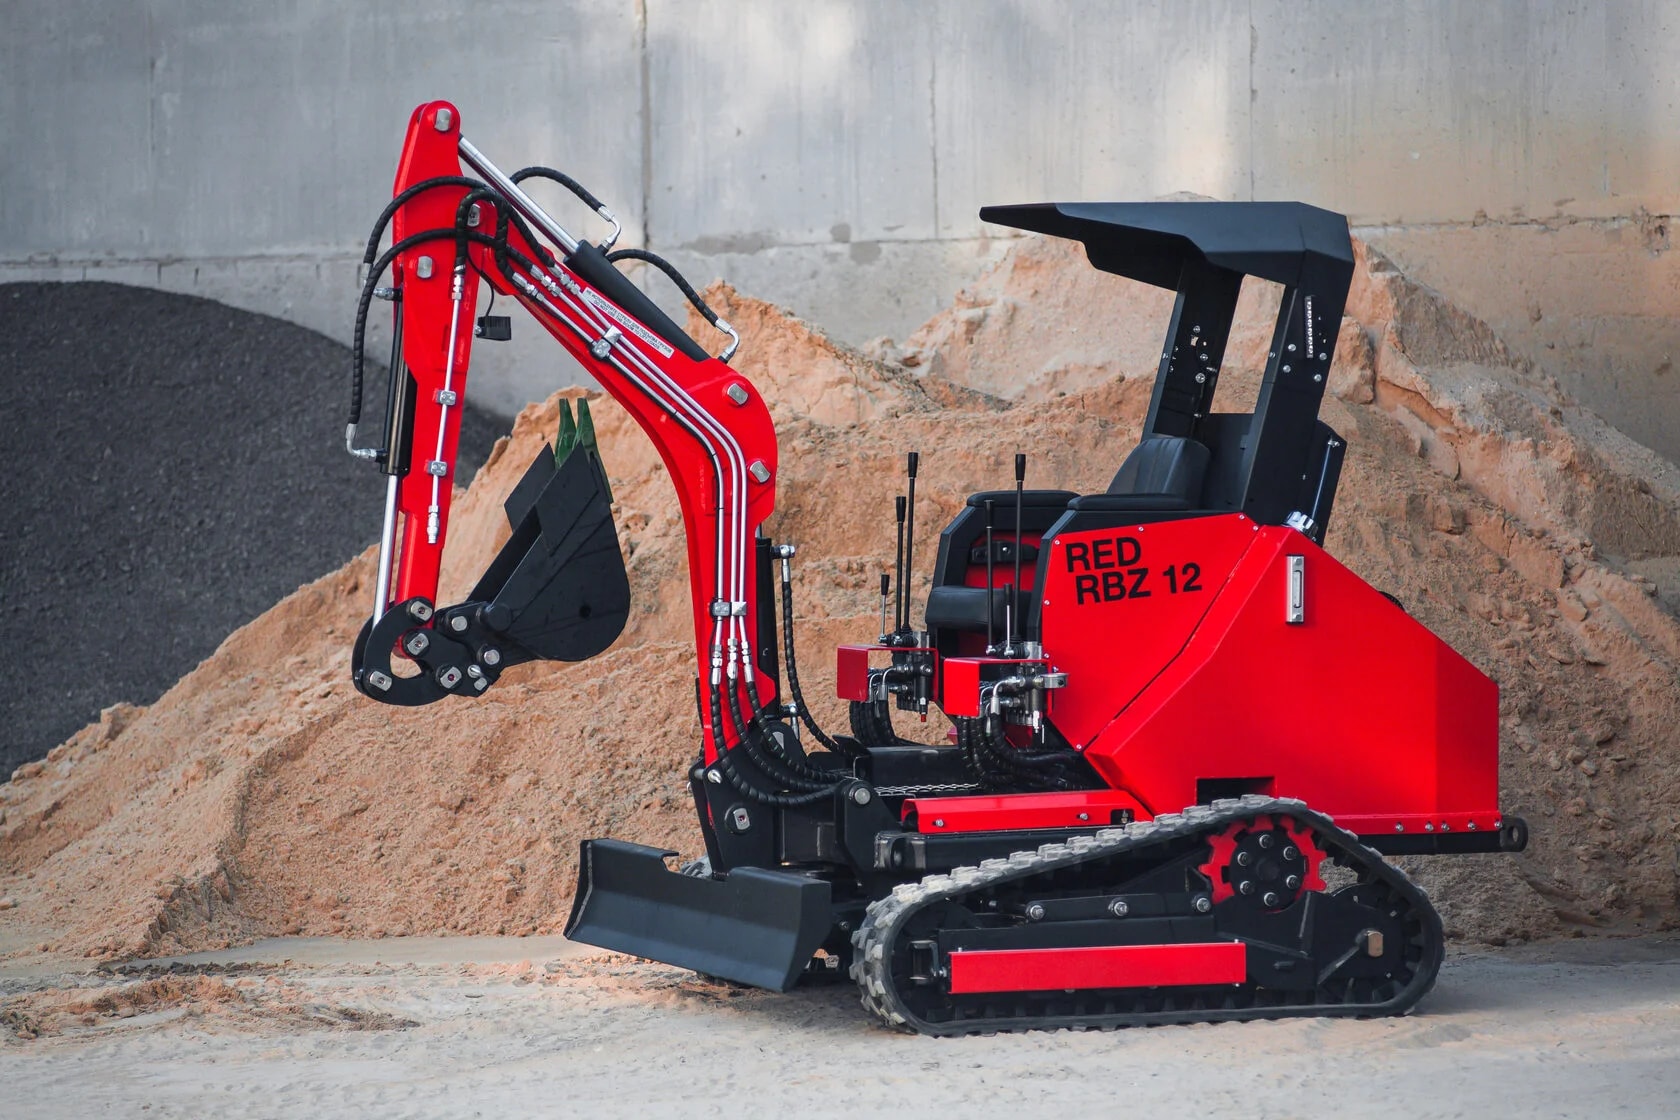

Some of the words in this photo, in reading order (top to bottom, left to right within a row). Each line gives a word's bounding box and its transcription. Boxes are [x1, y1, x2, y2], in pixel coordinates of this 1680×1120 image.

[1066, 537, 1141, 573] RED
[1076, 567, 1152, 605] RBZ
[1162, 562, 1202, 594] 12
